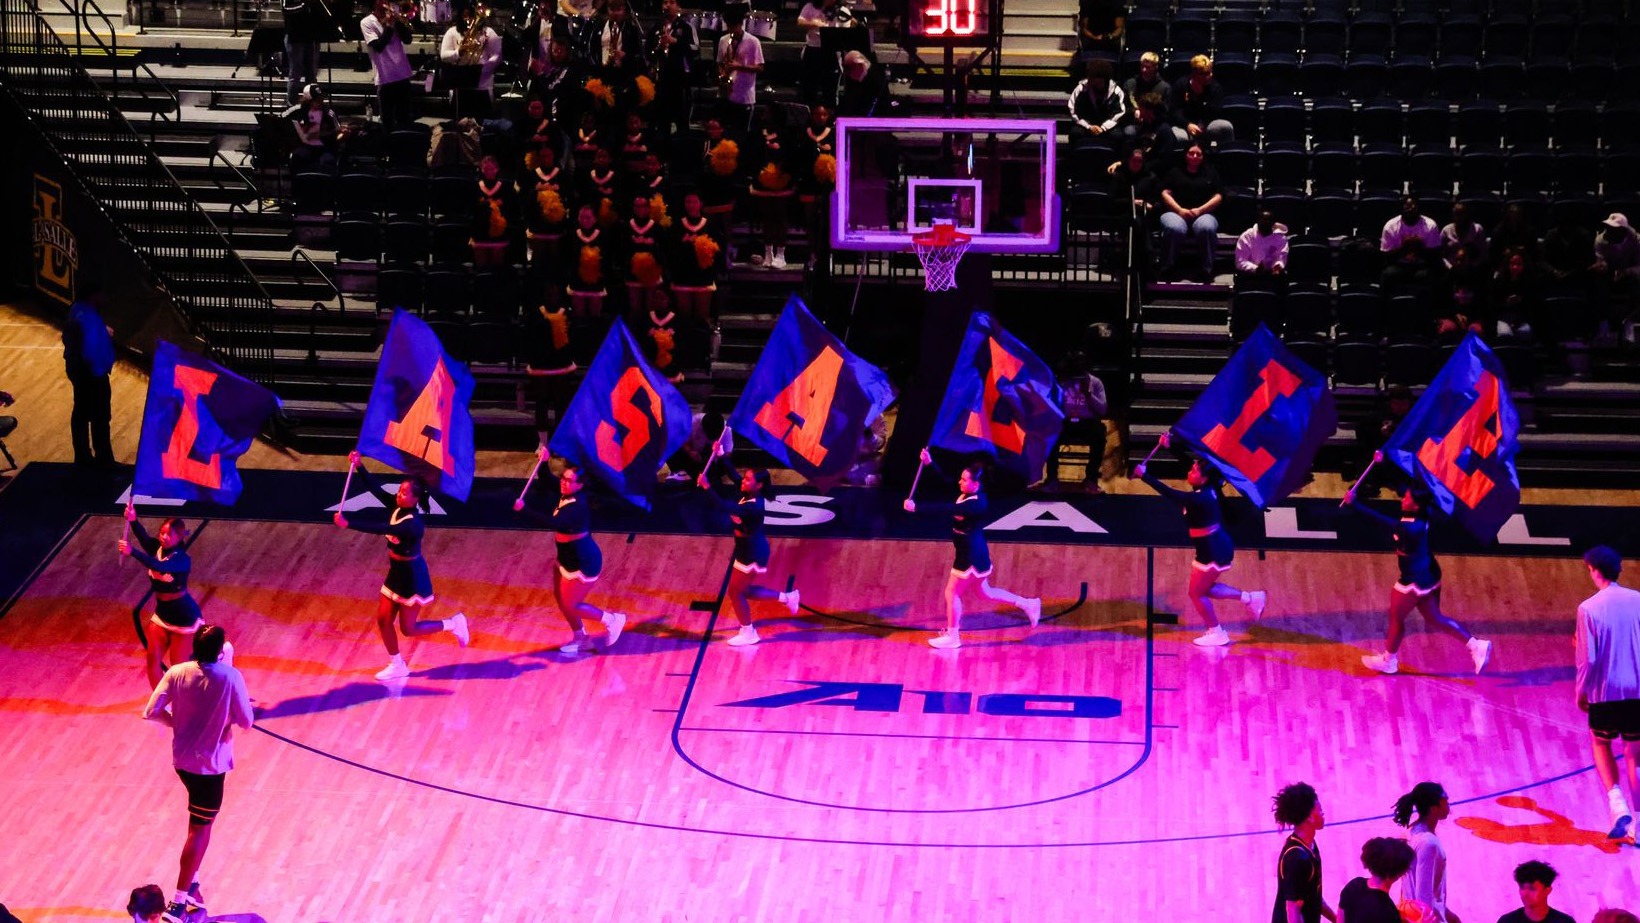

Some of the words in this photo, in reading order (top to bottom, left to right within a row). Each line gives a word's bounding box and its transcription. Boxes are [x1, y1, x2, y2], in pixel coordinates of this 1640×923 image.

[924, 0, 975, 35] 30
[161, 364, 222, 489] L
[383, 355, 456, 478] A
[595, 366, 663, 472] S
[754, 345, 844, 467] A
[1202, 359, 1302, 482] L
[1417, 370, 1502, 510] E
